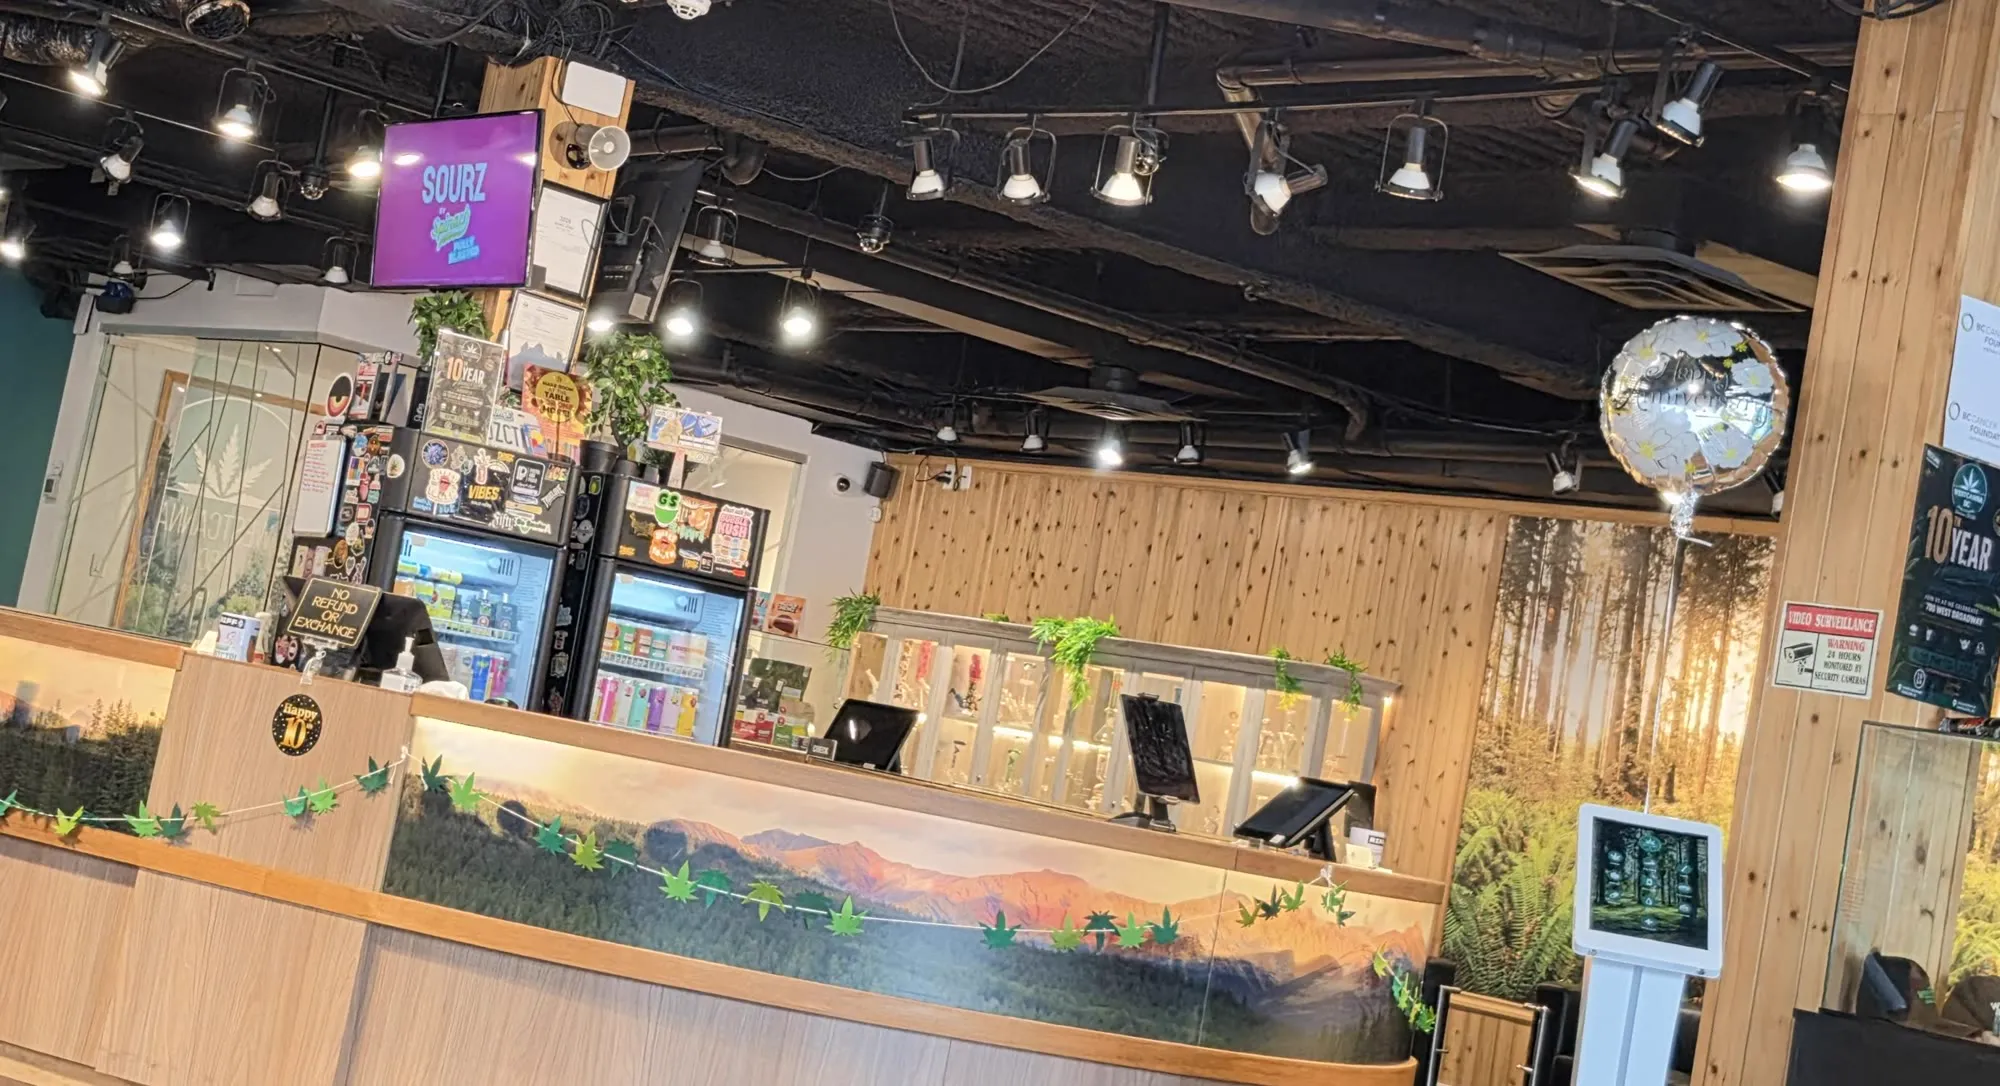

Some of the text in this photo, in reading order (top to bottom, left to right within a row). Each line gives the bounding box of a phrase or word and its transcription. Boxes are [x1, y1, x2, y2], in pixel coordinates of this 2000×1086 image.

[422, 163, 488, 204] SOURZ
[447, 356, 486, 385] 10 YEAR
[544, 391, 570, 402] TABLE
[468, 484, 500, 500] VIBES
[659, 493, 678, 507] GS
[719, 522, 748, 537] KUSH
[1924, 505, 1954, 564] 10
[1950, 527, 1993, 572] YEAR
[331, 588, 350, 600] NO
[312, 595, 358, 615] REFUND
[321, 610, 340, 623] OR
[1788, 610, 1875, 633] VIDEO SURVEILLANCE
[1936, 605, 1951, 618] WEST
[1951, 610, 1984, 627] BROADWAY
[294, 616, 357, 639] EXCHANGE
[1827, 638, 1866, 652] WARNING
[1827, 650, 1862, 662] 24 HOURS
[1823, 660, 1863, 673] MONITORED BY
[1814, 671, 1866, 686] SECURITY CAMERAS
[283, 702, 318, 722] Happy
[280, 716, 307, 749] 10
